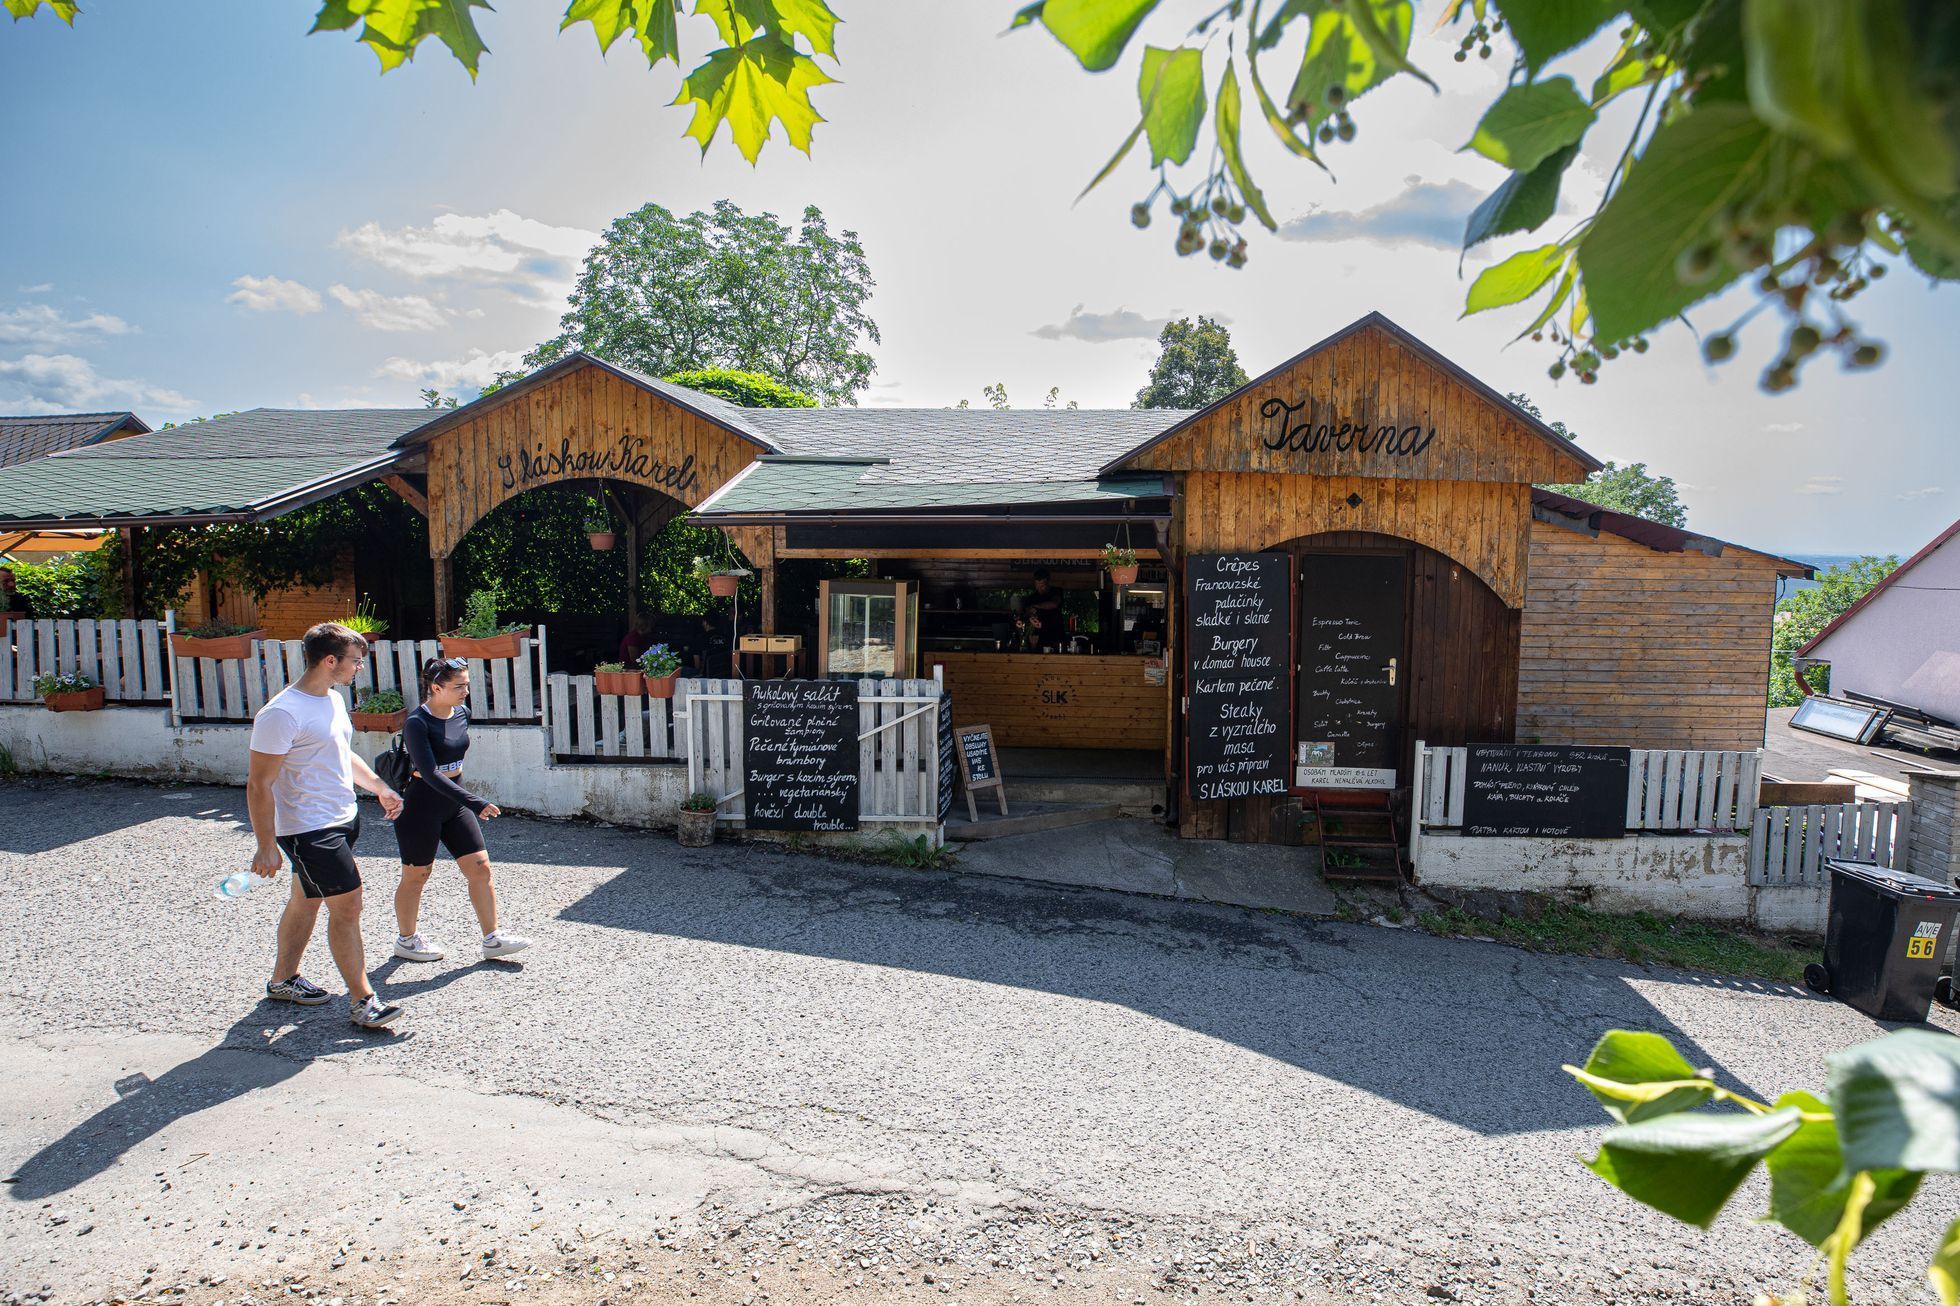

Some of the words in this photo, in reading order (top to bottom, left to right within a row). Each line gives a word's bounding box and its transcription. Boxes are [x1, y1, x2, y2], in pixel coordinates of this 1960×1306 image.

[1261, 398, 1436, 456] Taverna
[611, 435, 697, 491] Karel
[1216, 556, 1260, 576] Crêpes
[1195, 576, 1261, 591] Francouzské
[1215, 593, 1264, 613] palačinky
[1195, 611, 1233, 626] sladké
[1236, 612, 1240, 624] i
[1244, 608, 1272, 624] slané
[1211, 635, 1259, 656] Burgery
[1194, 660, 1200, 670] v
[1202, 654, 1238, 669] domácí
[1241, 653, 1271, 668] housce
[752, 685, 799, 702] Rukolový
[803, 686, 841, 701] salát
[1196, 679, 1235, 694] Karlem
[1239, 677, 1276, 696] pečené
[1042, 690, 1068, 704] SLK
[1220, 701, 1263, 720] Steaky
[750, 714, 803, 727] Grilované
[785, 728, 826, 738] žampiony
[1209, 726, 1218, 738] z
[1222, 718, 1276, 742] vyzrálého
[749, 737, 790, 752] Pečené
[964, 741, 987, 751] OBSLUHY
[1224, 742, 1255, 755] masa
[776, 755, 826, 769] brambory
[977, 764, 985, 772] KE
[1197, 764, 1213, 778] pro
[1218, 759, 1235, 773] vás
[1237, 754, 1272, 775] připraví
[1516, 762, 1551, 773] VLASTNÍ
[749, 770, 785, 789] Burger
[787, 773, 794, 782] s
[797, 770, 825, 783] kozím
[972, 772, 989, 782] STOLU
[779, 785, 849, 804] vegetariánský
[1200, 783, 1208, 799] S
[1210, 779, 1249, 799] LÁSKOU
[1253, 779, 1288, 794] KAREL
[754, 802, 789, 818] hovězí
[794, 803, 827, 819] double
[1917, 925, 1939, 935] AVE
[1911, 940, 1933, 956] 56
